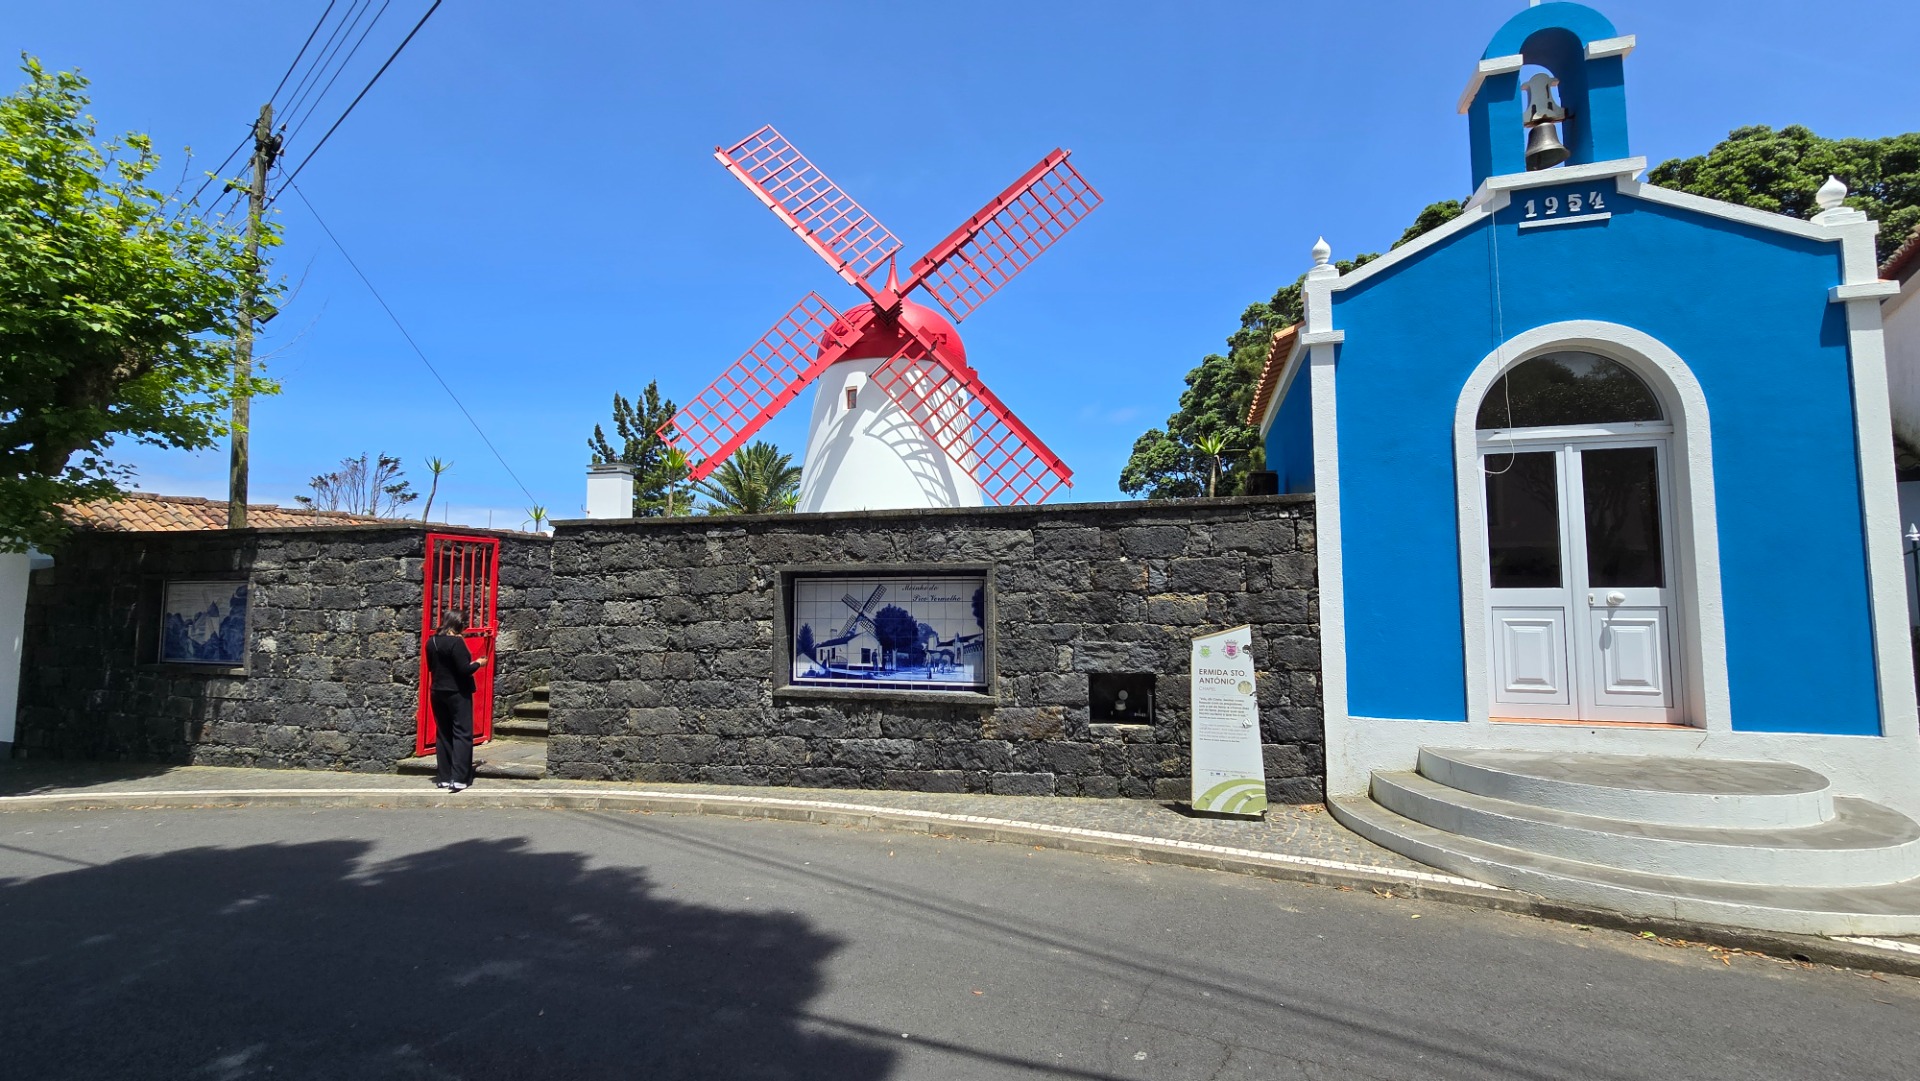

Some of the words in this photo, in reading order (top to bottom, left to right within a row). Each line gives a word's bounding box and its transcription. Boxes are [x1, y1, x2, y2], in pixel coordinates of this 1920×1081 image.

[1524, 191, 1605, 218] 1954
[930, 594, 962, 602] Vermelho
[1198, 668, 1229, 676] ERMIDA
[1230, 669, 1248, 678] STO.
[1198, 676, 1236, 686] ANTÓNIO
